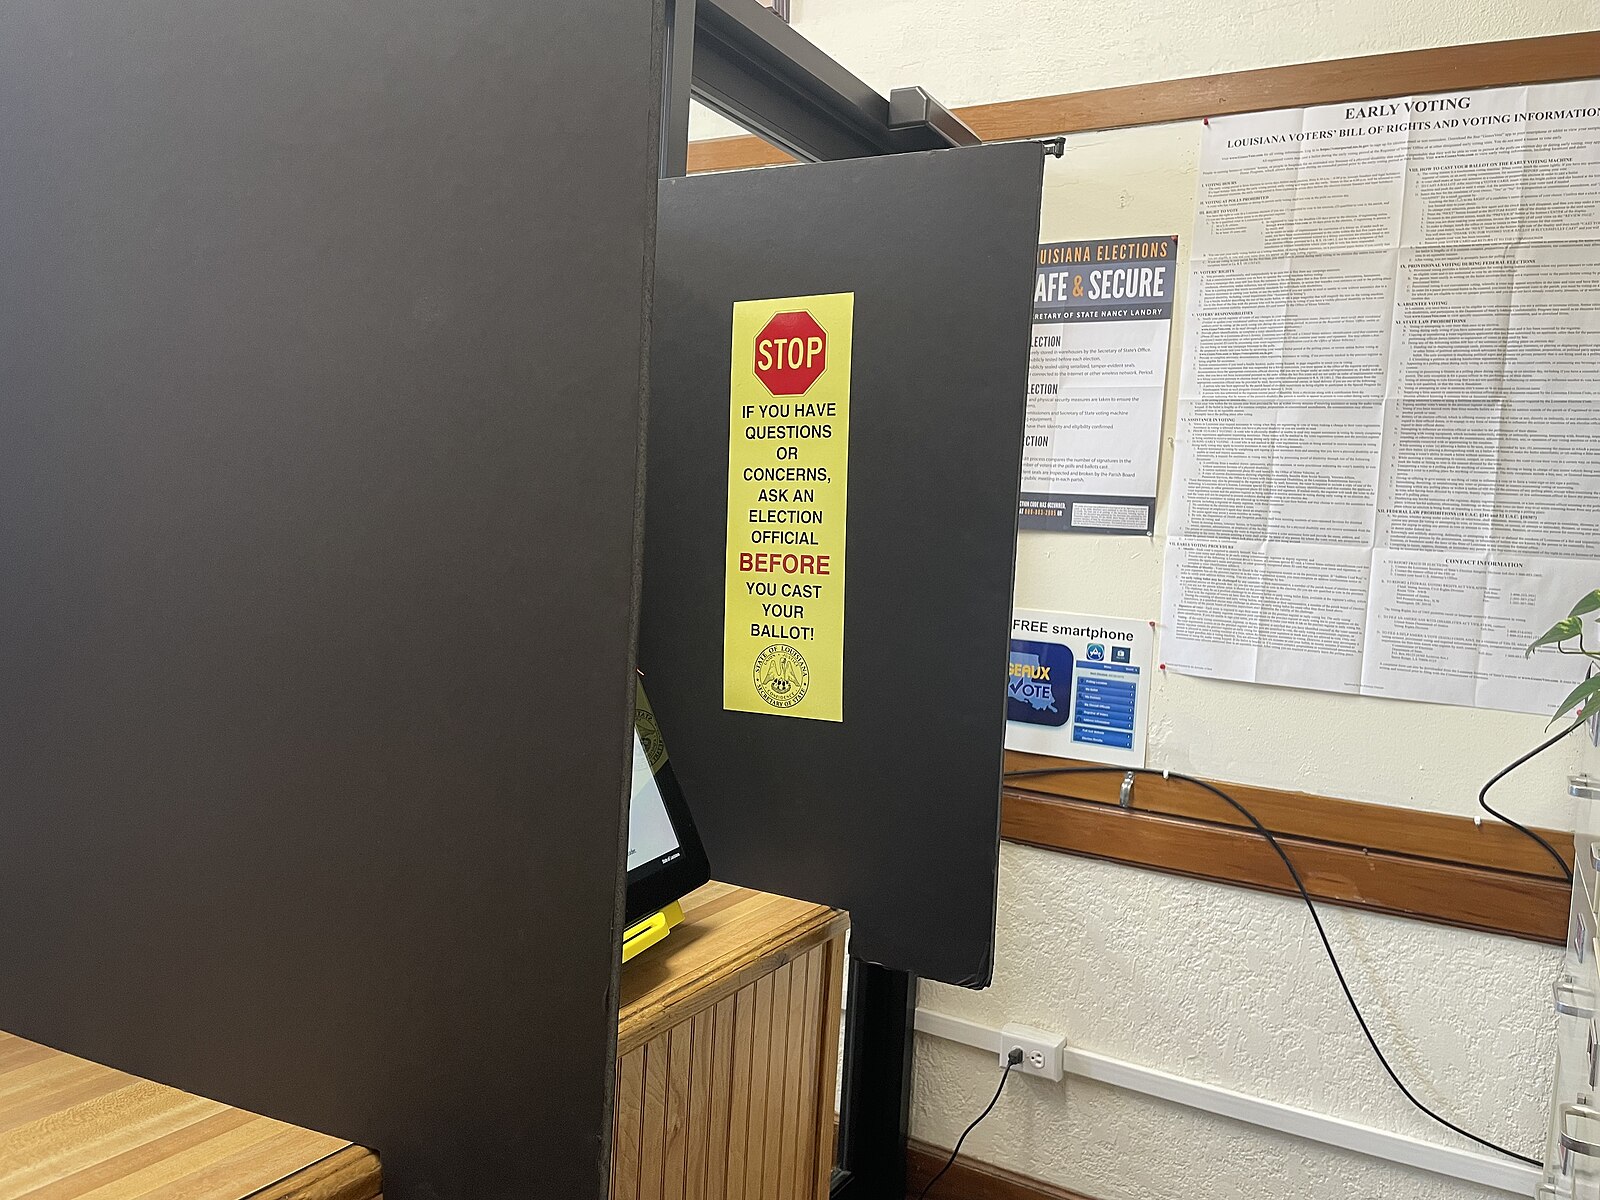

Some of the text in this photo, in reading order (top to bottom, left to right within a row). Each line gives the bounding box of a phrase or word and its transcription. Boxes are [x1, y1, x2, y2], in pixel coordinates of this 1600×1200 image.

[1345, 97, 1470, 120] EARLY VOTING
[1227, 135, 1286, 148] LOUISIANA
[1339, 129, 1366, 138] BILL
[1368, 126, 1384, 134] OF
[1387, 121, 1431, 134] RIGHTS
[1433, 119, 1459, 129] AND
[1462, 115, 1511, 126] VOTING
[1040, 242, 1168, 264] UISIANA ELECTIONS
[1034, 272, 1068, 302] AFE
[1072, 275, 1083, 296] &
[1088, 267, 1165, 300] SECURE
[1034, 312, 1062, 320] RETARY
[1131, 308, 1162, 316] LANDRY
[1031, 336, 1061, 347] ECTION
[758, 337, 823, 370] STOP
[742, 403, 836, 418] IF YOU HAVE
[746, 425, 832, 439] QUESTIONS
[1024, 436, 1048, 447] CTION
[777, 447, 797, 460] OR
[744, 468, 831, 483] CONCERNS,
[758, 489, 813, 502] ASK AN
[749, 510, 822, 523] ELECTION
[752, 530, 818, 545] OFFICIAL
[740, 553, 830, 575] BEFORE
[746, 582, 822, 598] YOU CAST
[762, 604, 803, 618] YOUR
[751, 624, 814, 640] BALLOT!
[1013, 620, 1134, 641] FREE smartphone
[756, 653, 767, 673] STATE
[781, 646, 807, 676] LOUISIANA
[757, 685, 783, 706] SECRETARY
[793, 688, 805, 703] STATE
